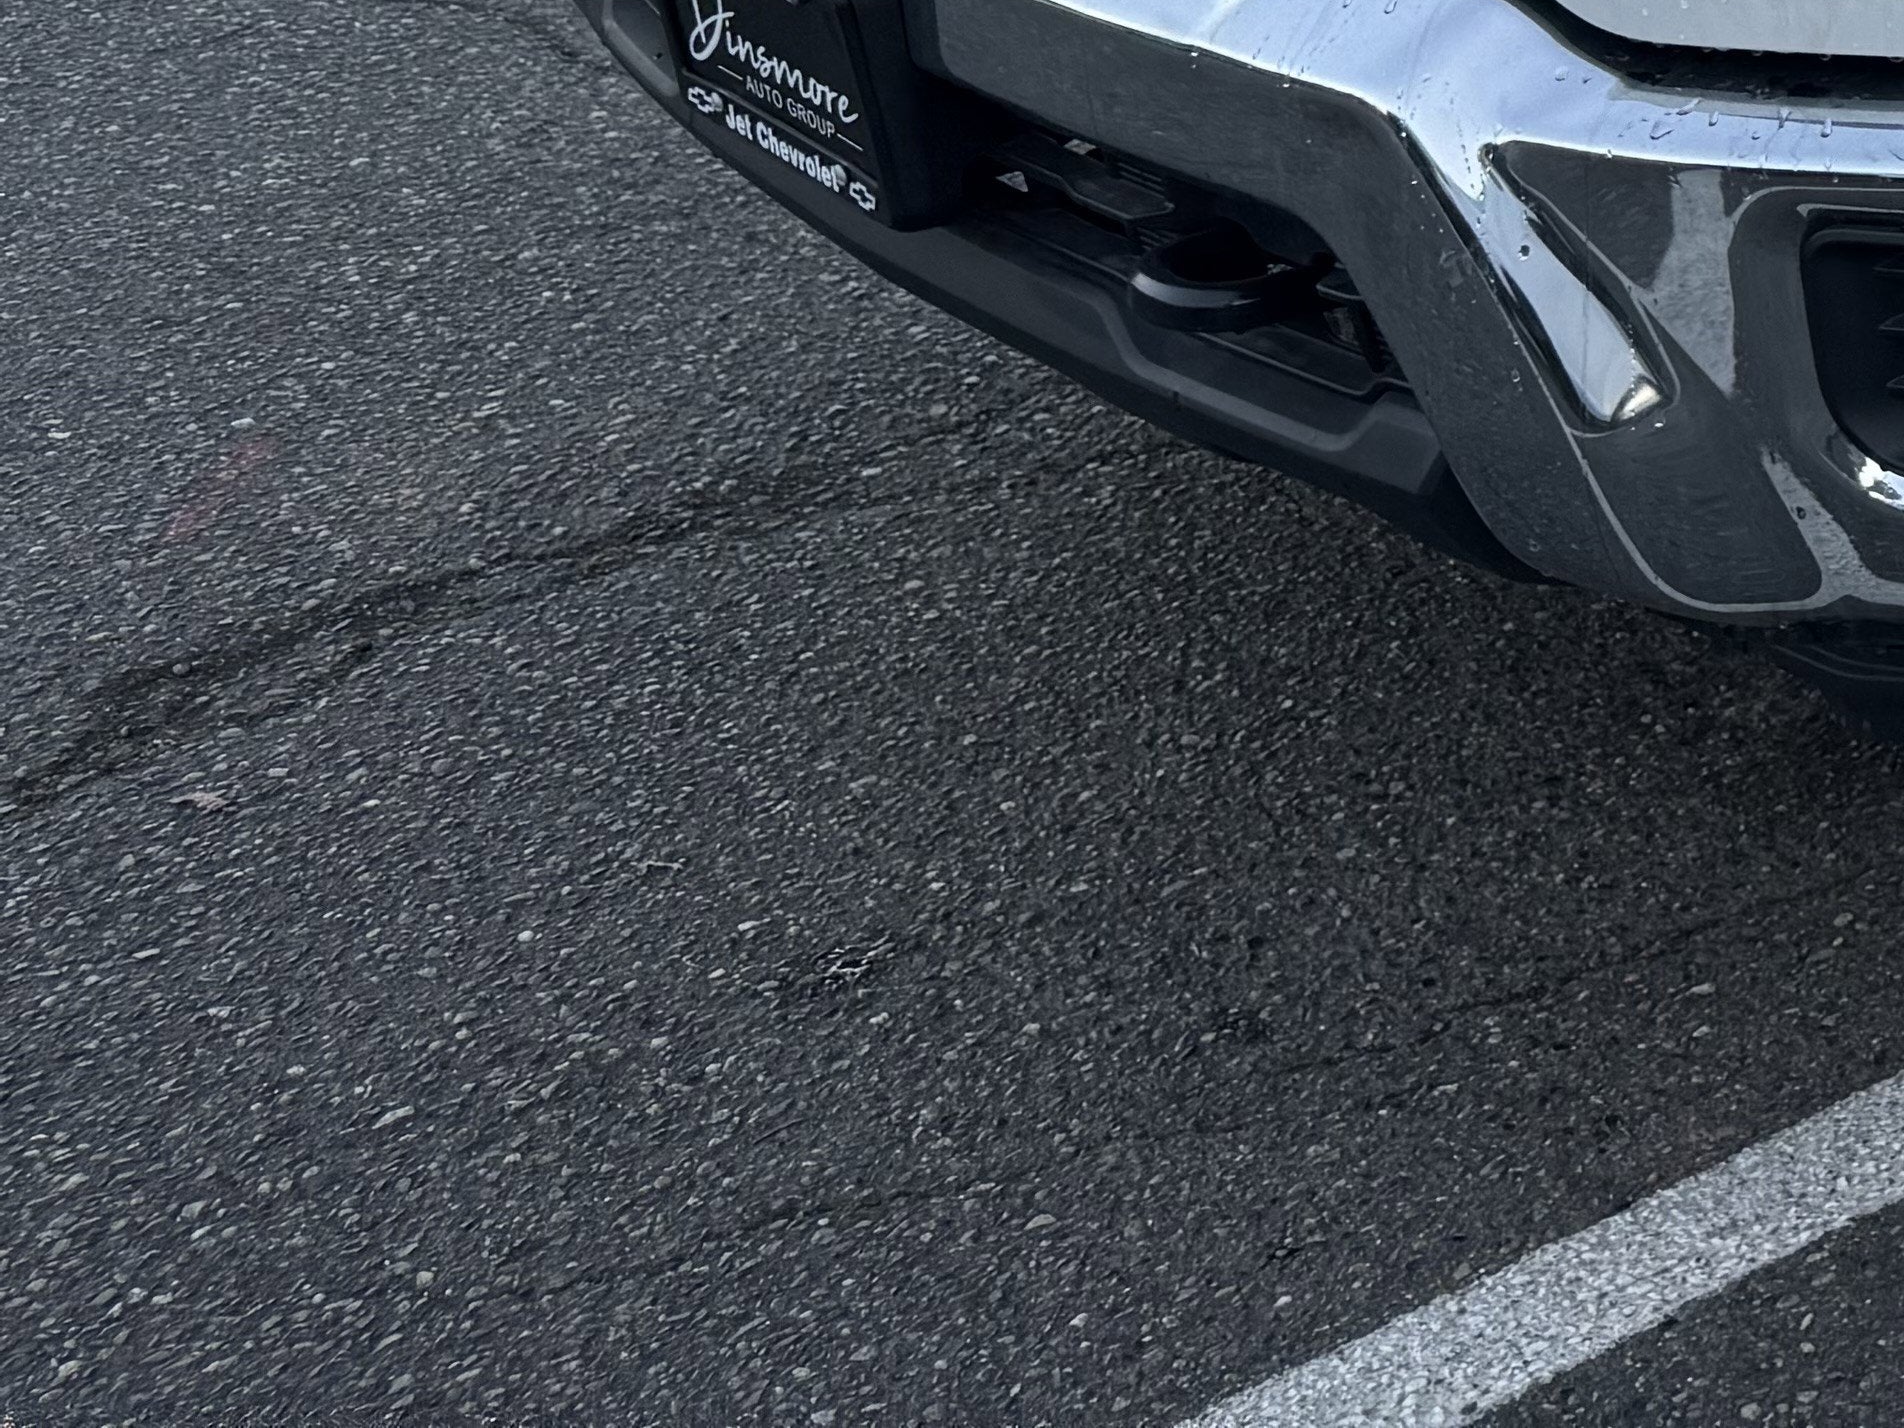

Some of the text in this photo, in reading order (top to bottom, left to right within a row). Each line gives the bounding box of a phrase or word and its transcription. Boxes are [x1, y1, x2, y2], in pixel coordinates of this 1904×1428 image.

[745, 74, 836, 139] AUTO GROUP
[724, 103, 841, 194] Jet Chevrolet
